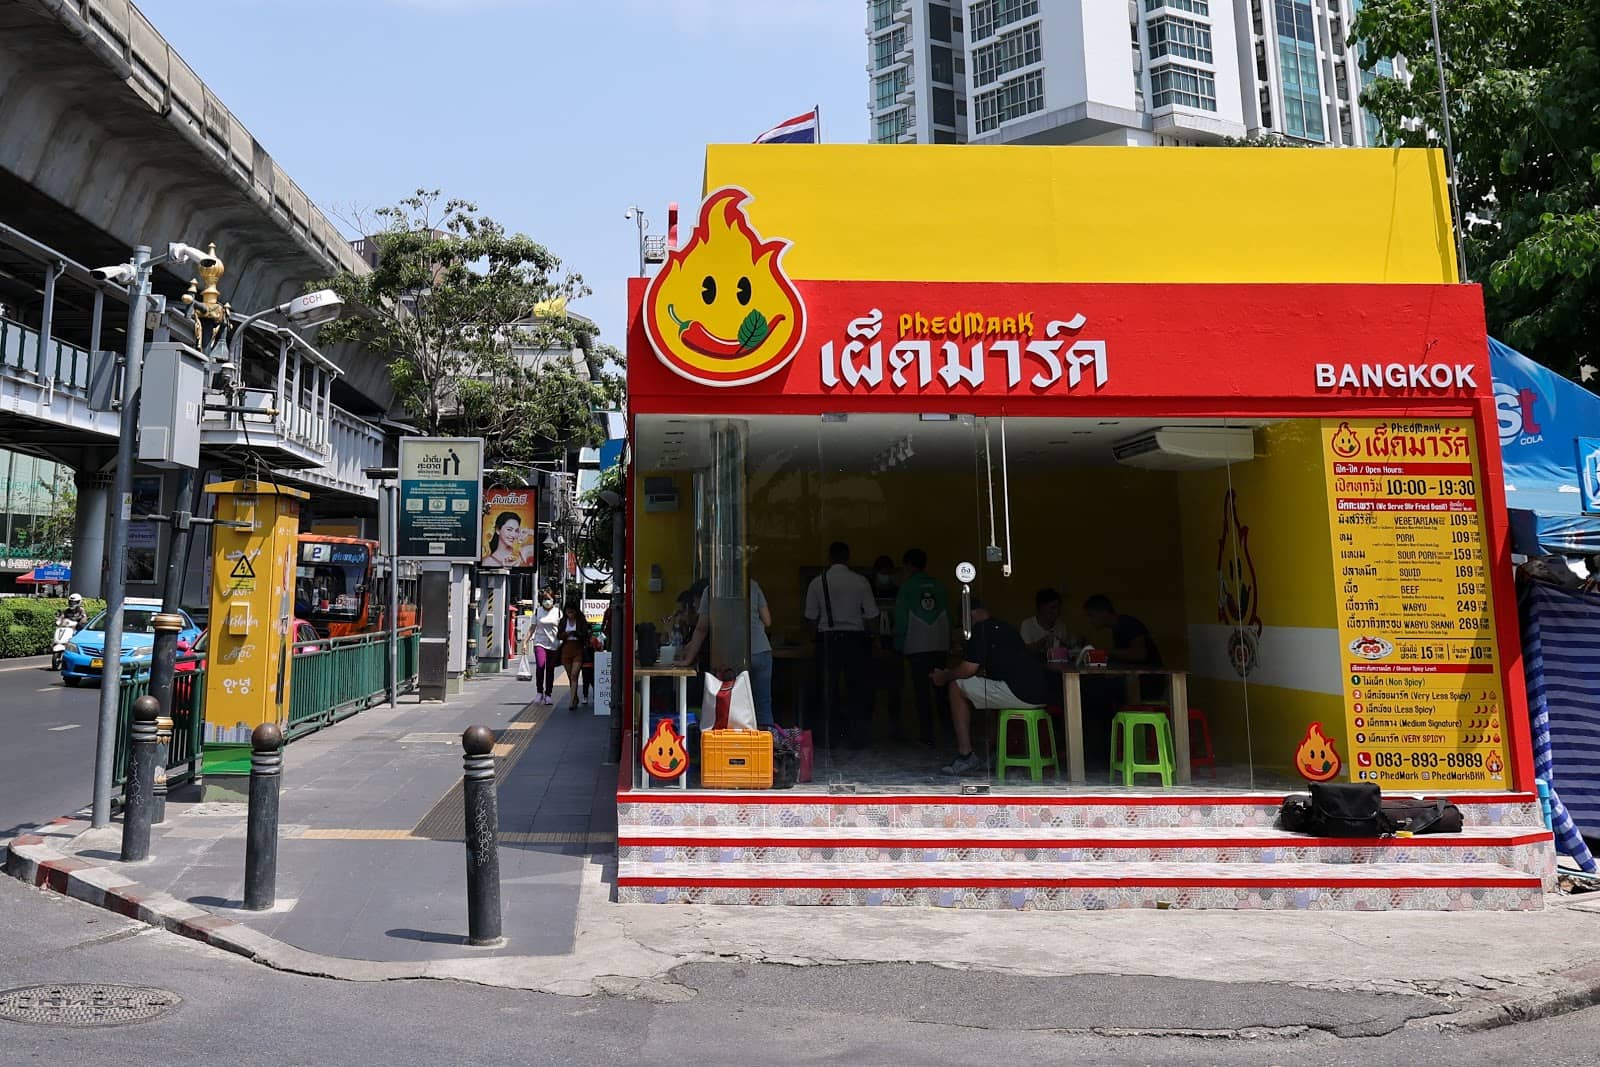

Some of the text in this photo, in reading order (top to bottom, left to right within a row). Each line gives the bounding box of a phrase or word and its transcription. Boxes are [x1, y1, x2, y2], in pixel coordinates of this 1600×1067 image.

[303, 294, 322, 306] CCH
[820, 308, 1108, 388] เผ็ดมาร์ค
[1315, 363, 1477, 388] BANGKOK
[1495, 388, 1541, 435] st
[1366, 423, 1470, 457] เผ็ดมาร์ค
[1520, 434, 1544, 446] COLA
[1365, 466, 1381, 475] Open
[1394, 517, 1438, 525] VEGETARIAN
[1450, 514, 1468, 526] 109
[1396, 533, 1415, 542] PORK
[1452, 531, 1470, 543] 109
[313, 547, 322, 559] 2
[1397, 551, 1417, 560] SOUR
[1418, 551, 1437, 560] PORK
[1453, 548, 1471, 560] 159
[1399, 567, 1421, 578] SQUID
[1455, 566, 1473, 577] 169
[1401, 585, 1420, 594] BEEF
[1457, 583, 1475, 594] 159
[1402, 603, 1427, 611] WAGYU
[1457, 600, 1477, 612] 249
[1404, 620, 1429, 629] WAGYU
[1459, 617, 1479, 629] 269
[1421, 646, 1433, 659] 15
[1470, 646, 1482, 659] 10
[223, 678, 251, 695] 안녕
[1431, 691, 1448, 700] Less
[1375, 752, 1483, 767] 083-893-8989
[1380, 771, 1419, 780] PhedMark
